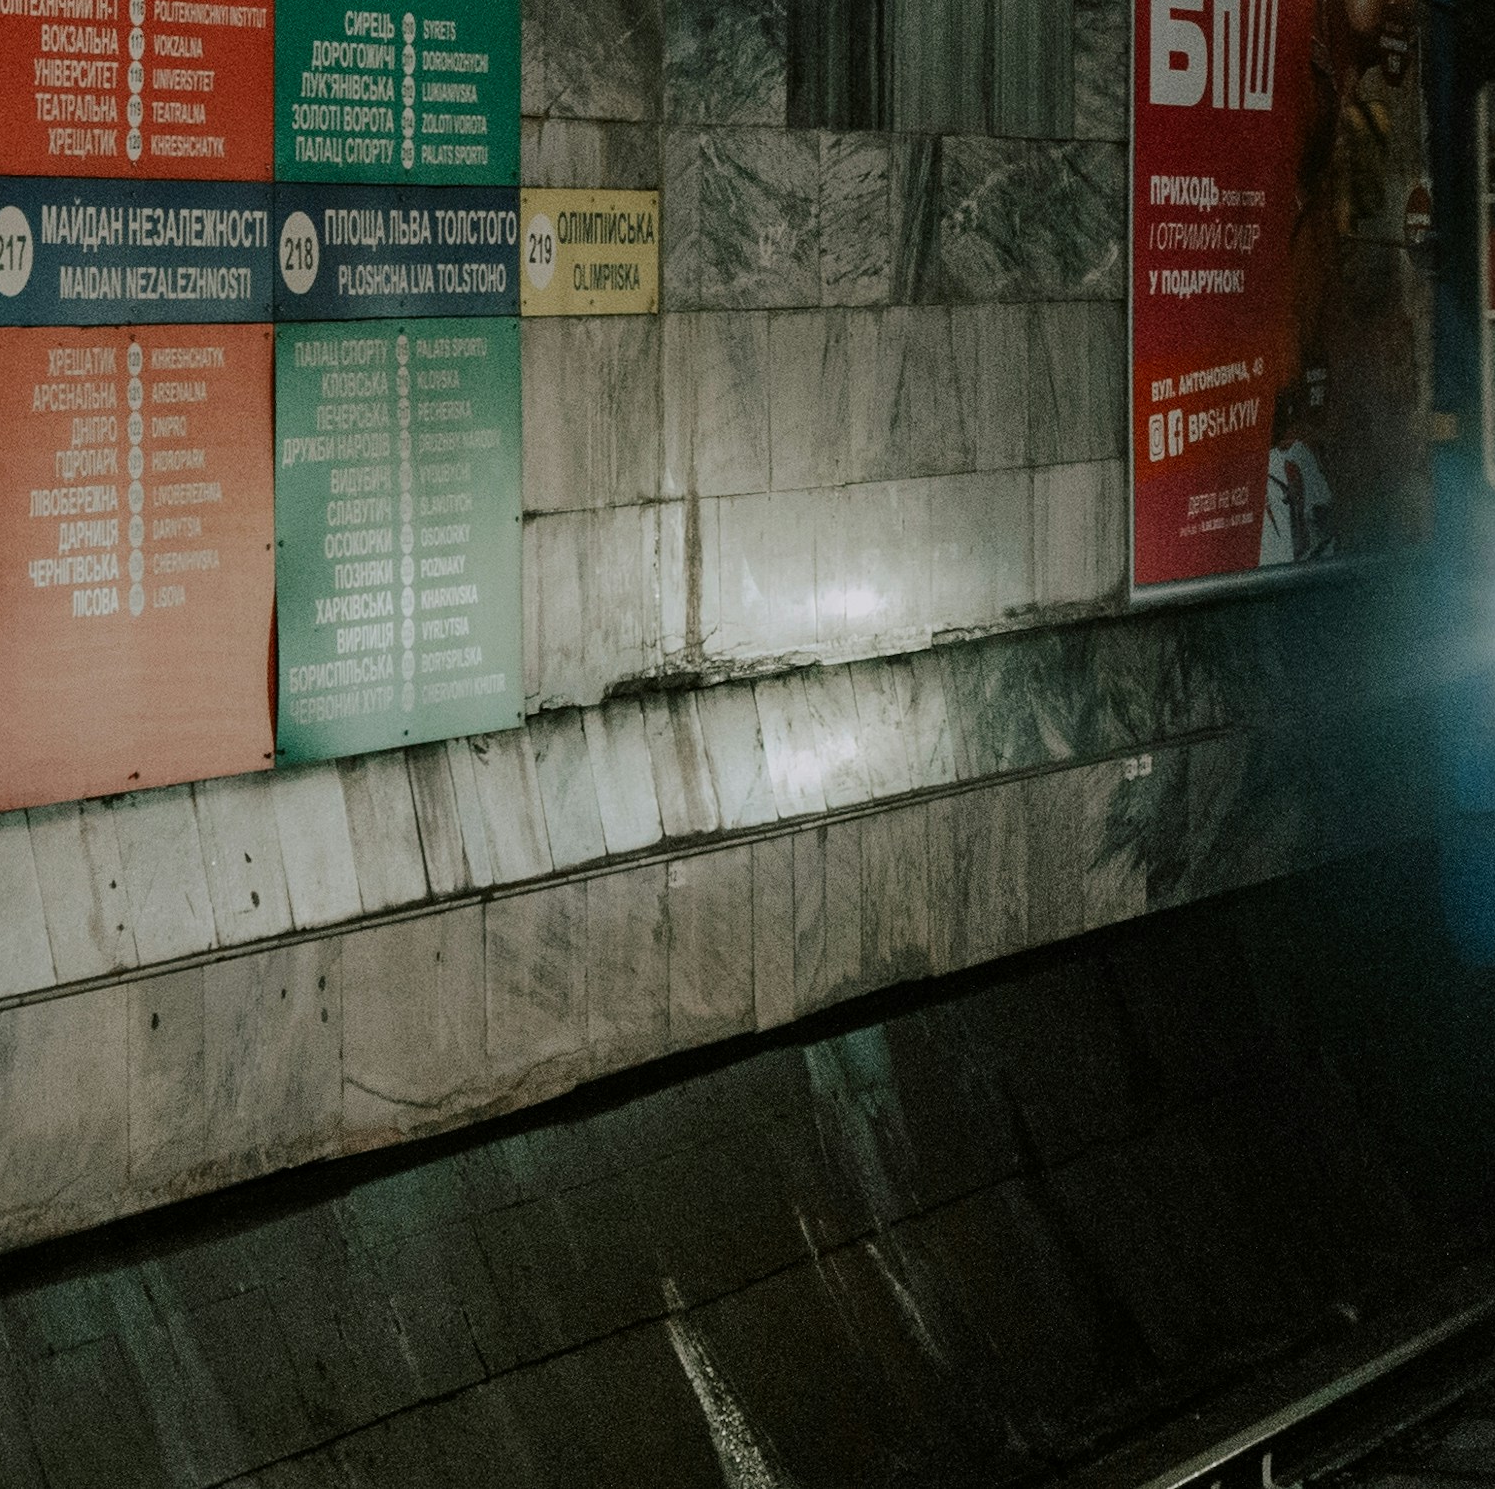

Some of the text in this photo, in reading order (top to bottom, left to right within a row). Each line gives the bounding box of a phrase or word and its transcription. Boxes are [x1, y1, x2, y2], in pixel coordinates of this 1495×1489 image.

[41, 24, 119, 55] ВОКЗАЛЬНА
[345, 10, 395, 42] СИРЕЦЬ
[423, 20, 456, 40] SYRETS
[154, 34, 203, 58] VOKZALNA
[312, 41, 395, 70] ДОРОГОЖИЧІ
[34, 58, 118, 89] УНІВЕРСИТЕТ
[152, 69, 215, 92] UNIVERSYTET
[35, 93, 118, 123] ТЕАТРАЛЬНА
[152, 101, 206, 124] TEATRALNA
[292, 104, 394, 132] ЗОЛОТІ ВОРОТА
[48, 127, 117, 160] ХРЕЩАТИК
[150, 134, 225, 158] KHRESHCHATYK
[295, 136, 394, 167] ПАЛАЦ СПОРТУ
[42, 198, 268, 252] МАЙДАН НЕЗАЛЕЖНОСТІ
[325, 209, 517, 252] ПЛОЩА ЛЬВА ТОЛСТОГО
[557, 204, 655, 246] ОЛІМПІЙСЬКА
[1149, 217, 1260, 255] І ОТРИМУЙ СИДР
[285, 236, 313, 271] 218
[529, 235, 552, 265] 219
[60, 267, 251, 300] MAIDAN NEZALEZHNOSTI
[339, 264, 506, 296] PLOSHCHA LVA TOLSTOHO
[573, 264, 640, 291] OLIMPIISKA
[1149, 269, 1245, 299] У ПОДАРУНОК!
[47, 347, 117, 377] ХРЕЩАТИК
[33, 383, 117, 412] АРСЕНАЛЬНА
[322, 371, 388, 398] КЛОВСЬКА
[72, 416, 117, 448] ДНІПРО
[317, 402, 389, 431] ПЕЧЕРСЬКА
[1189, 397, 1260, 442] BPSH.KYIV
[56, 449, 118, 482] ГІДРОПАРК
[282, 436, 336, 469] ДРУЖБИ
[338, 432, 390, 459] НАРОДІВ
[30, 485, 118, 518] ЛІВОБЕРЕЖНА
[327, 497, 392, 527] СЛАВУТИЧ
[59, 518, 119, 555] ДАРНИЦЯ
[325, 528, 392, 559] ОСОКОРКИ
[28, 553, 119, 587] ЧЕРНІГІВСЬКА
[335, 560, 393, 590] ПОЗНЯКИ
[73, 587, 119, 617] ЛІСОВА
[315, 591, 394, 624] ХАРКІВСЬКА
[337, 622, 394, 654] ВИРЛИЦЯ
[290, 655, 394, 693] БОРИСПІЛЬСЬКА
